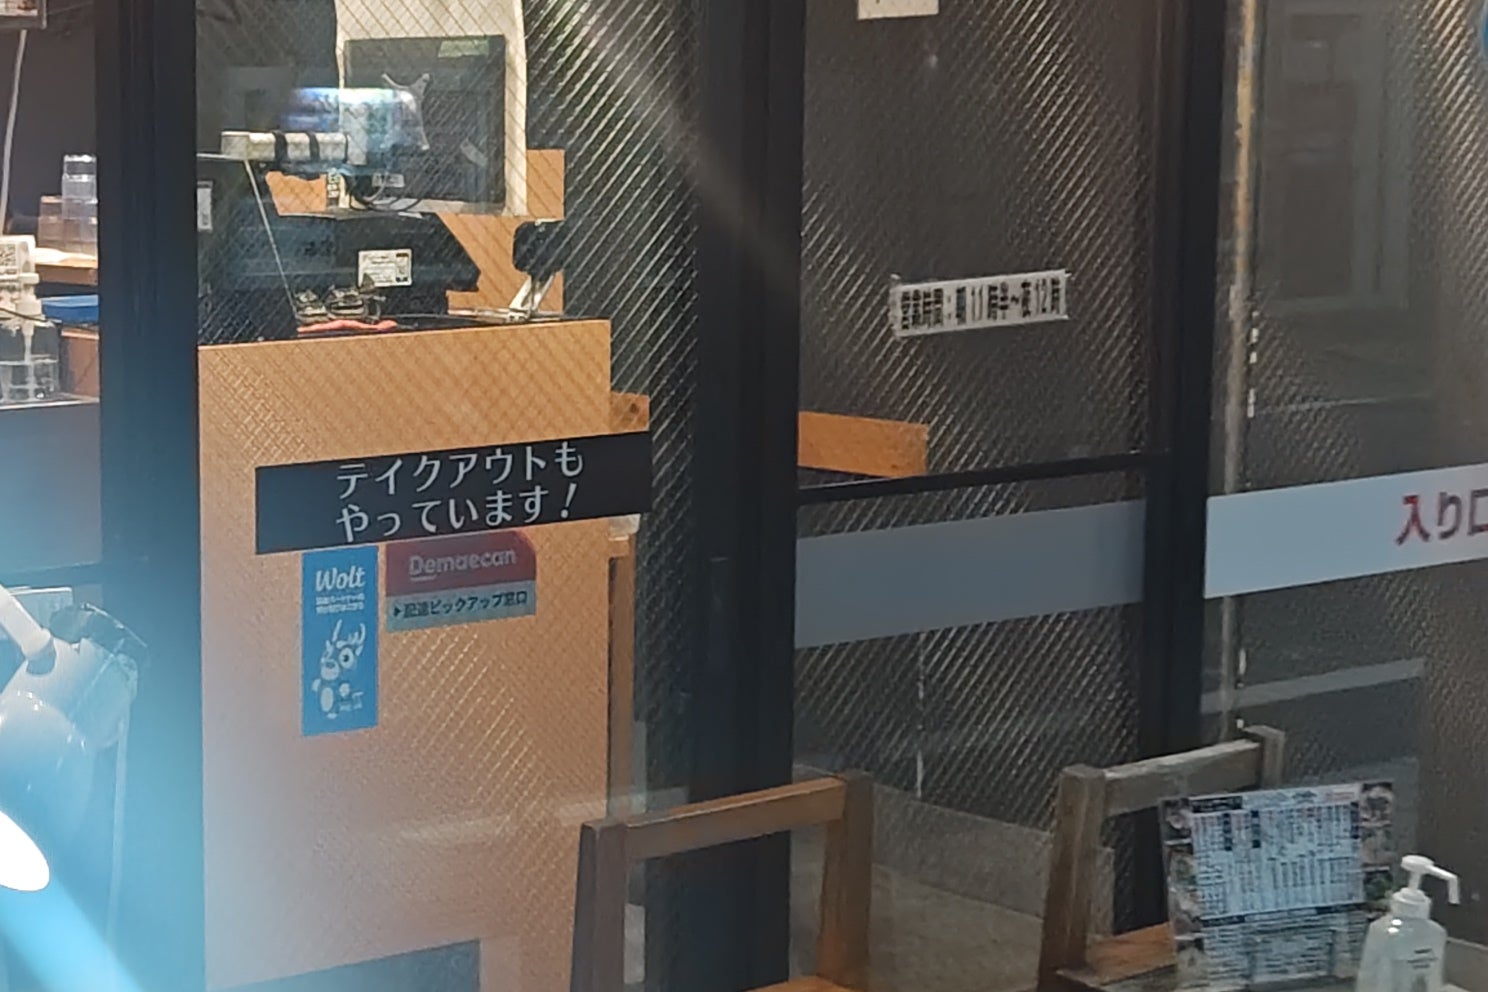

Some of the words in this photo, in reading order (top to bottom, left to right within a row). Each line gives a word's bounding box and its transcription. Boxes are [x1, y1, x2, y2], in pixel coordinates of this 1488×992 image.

[336, 440, 584, 500] テイクアウトも
[335, 482, 578, 543] やっています！
[1394, 488, 1488, 547] 入り口
[315, 565, 366, 592] Wolt
[408, 549, 517, 576] Demaecan
